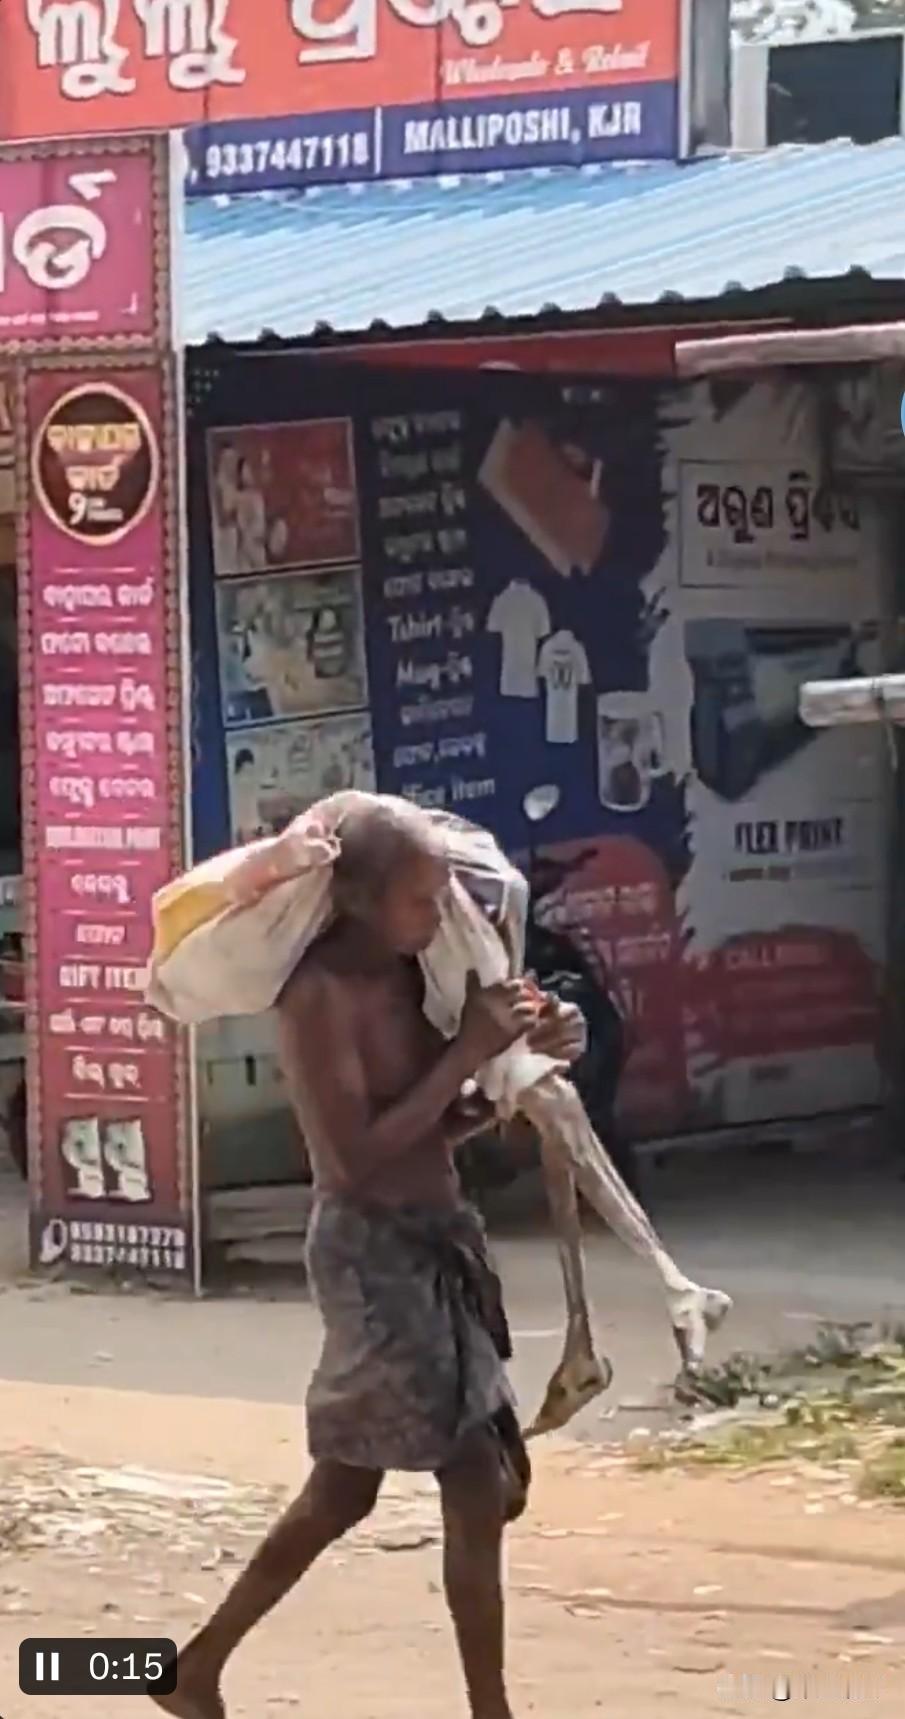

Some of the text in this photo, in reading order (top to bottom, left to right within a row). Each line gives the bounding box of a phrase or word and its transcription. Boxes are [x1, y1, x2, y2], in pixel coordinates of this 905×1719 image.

[205, 101, 642, 179] 9337447118 MALLIPOSHI, KJR
[733, 819, 779, 855] FLEX
